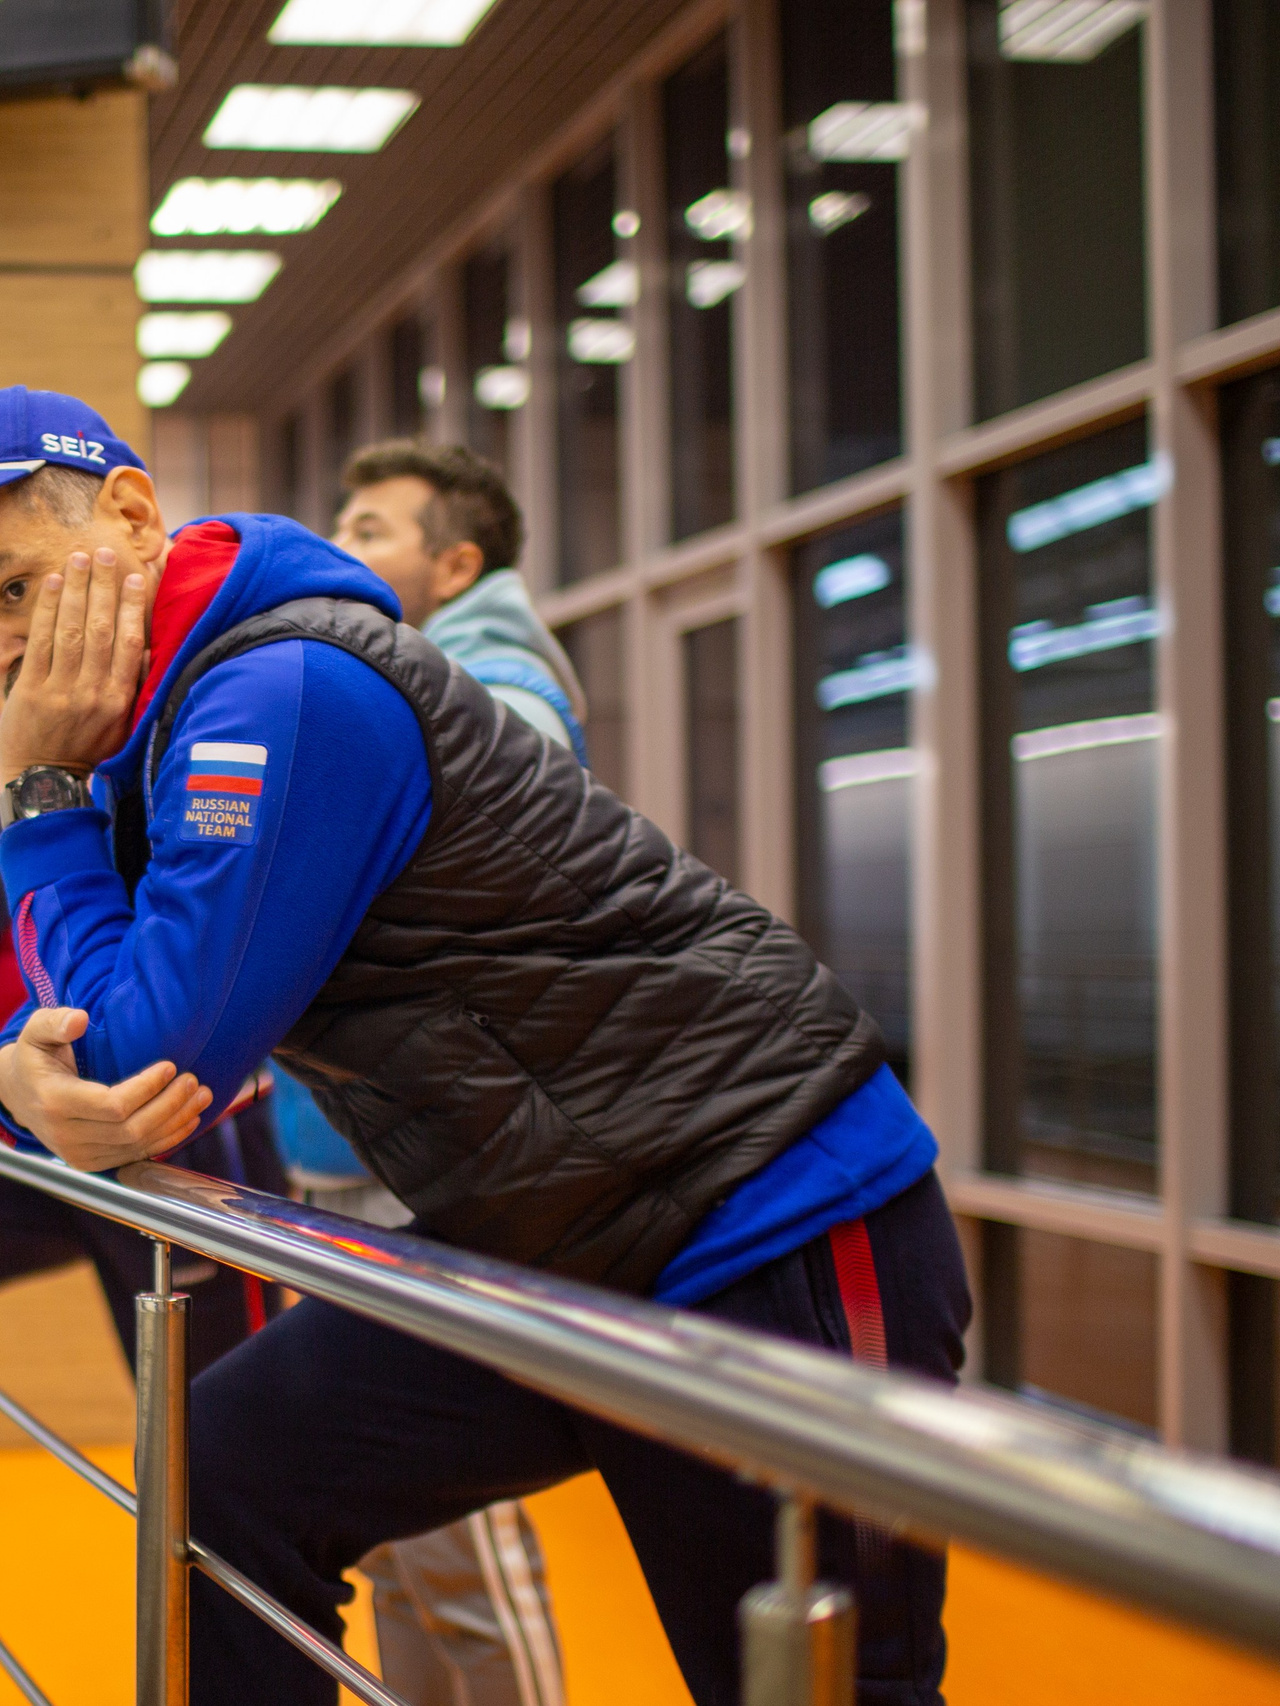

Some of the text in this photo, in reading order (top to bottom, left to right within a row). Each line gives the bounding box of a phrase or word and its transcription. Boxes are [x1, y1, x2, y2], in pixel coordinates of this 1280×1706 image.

[191, 798, 250, 814] RUSSIAN
[185, 810, 253, 827] NATIONAL
[197, 823, 236, 838] TEAM
